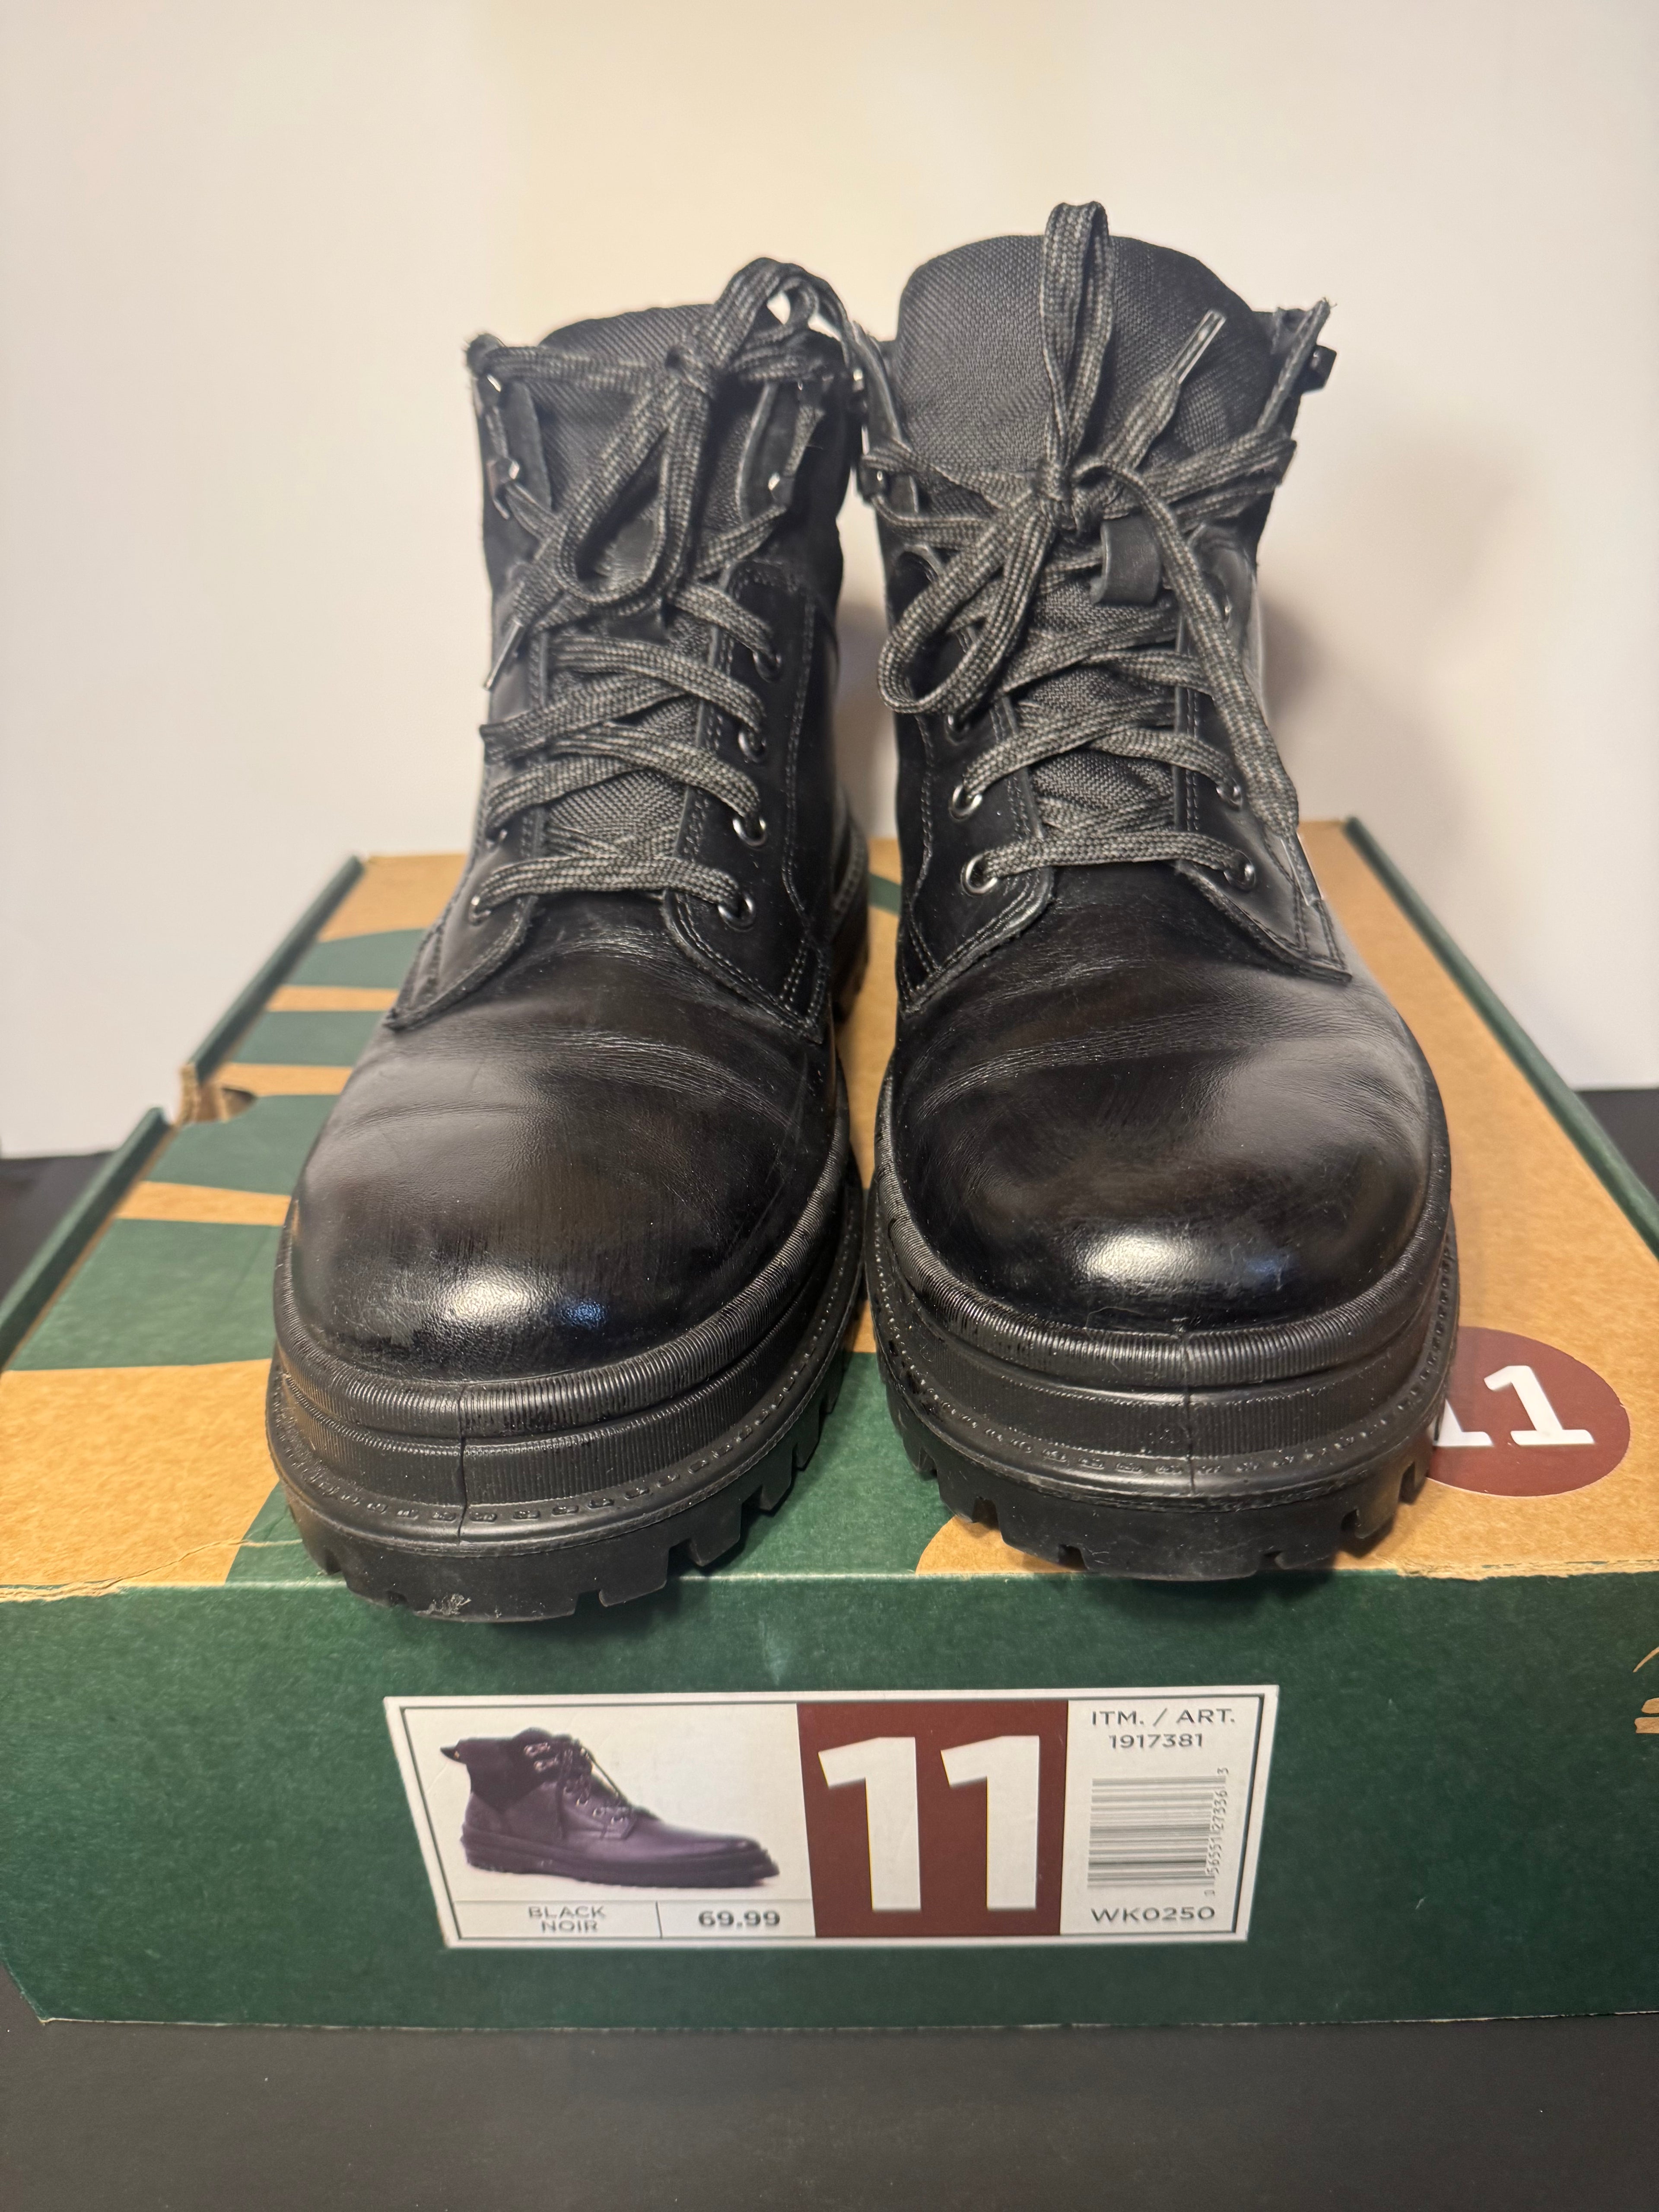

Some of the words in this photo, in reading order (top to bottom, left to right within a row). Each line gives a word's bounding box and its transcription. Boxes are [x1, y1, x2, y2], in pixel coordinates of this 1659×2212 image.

[1092, 1710, 1144, 1726] ITM.
[1152, 1707, 1168, 1727] /
[1176, 1708, 1236, 1724] ART.
[1109, 1733, 1203, 1749] 1917381
[818, 1735, 1039, 1912] 11
[528, 1906, 606, 1919] BLACK
[698, 1910, 781, 1928] 69.99
[540, 1920, 598, 1934] NOIR
